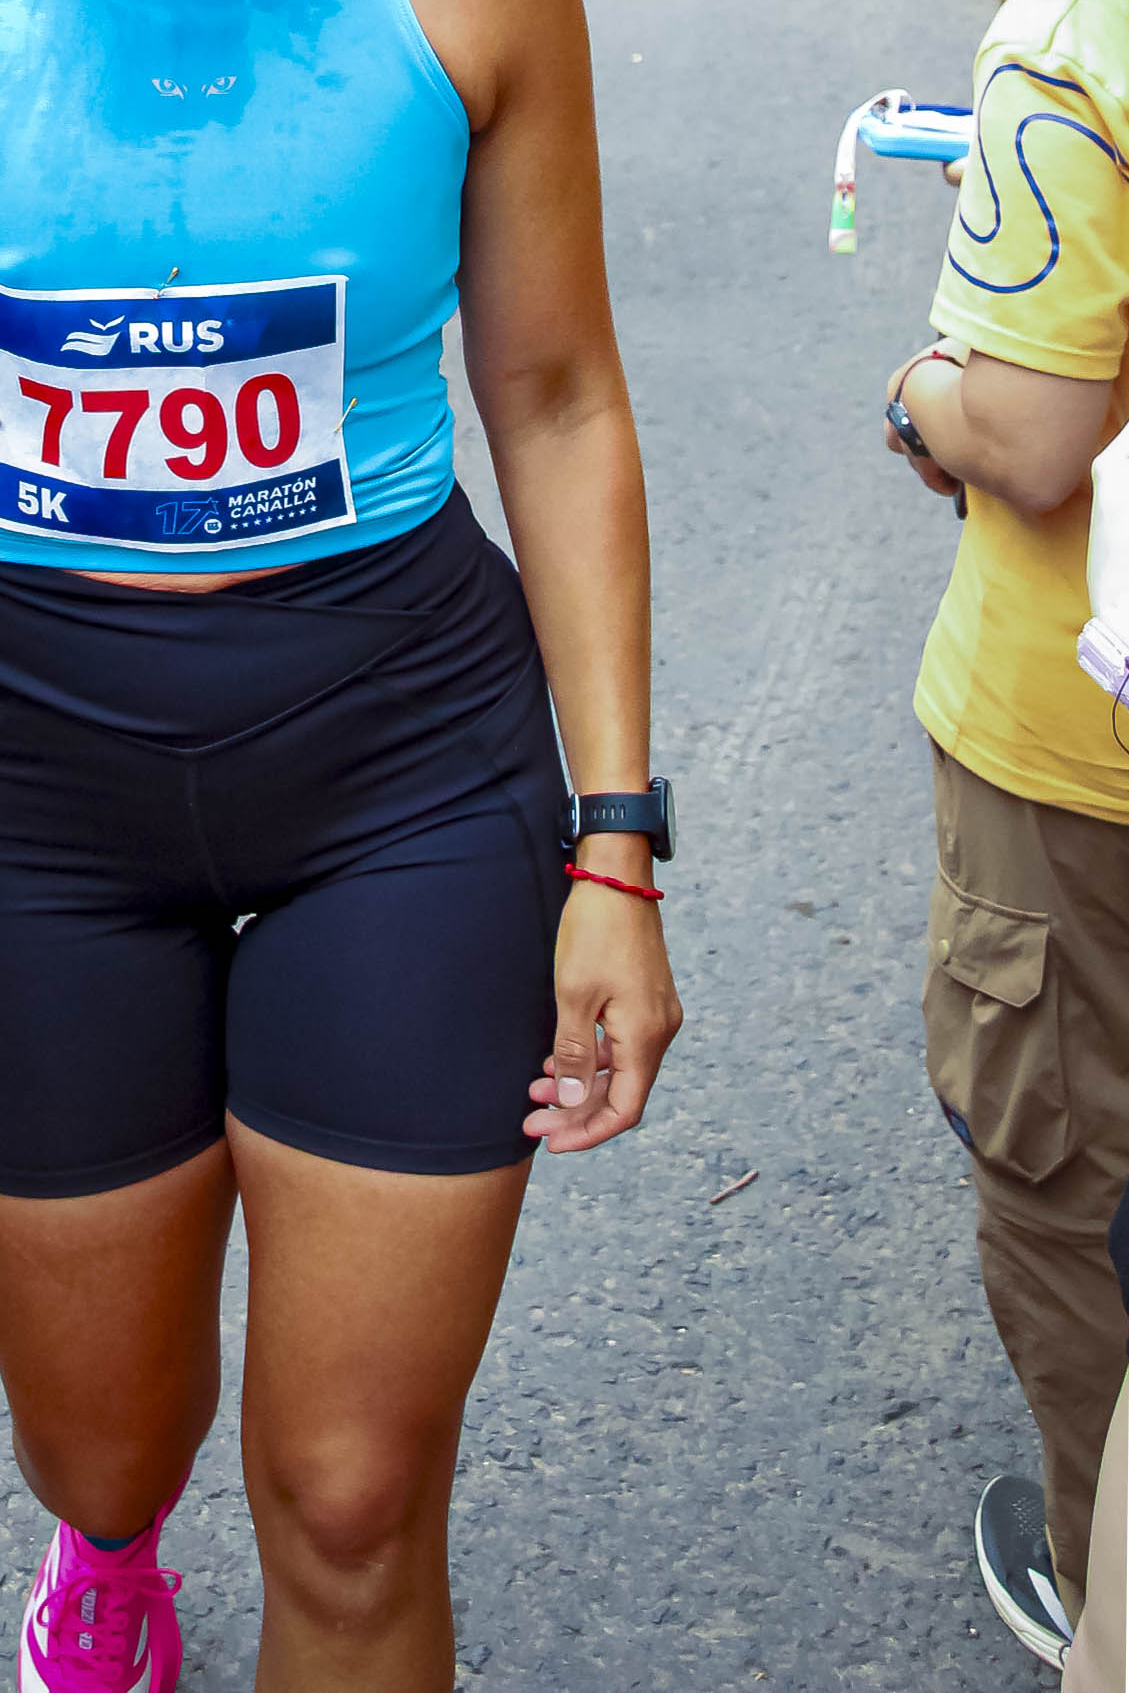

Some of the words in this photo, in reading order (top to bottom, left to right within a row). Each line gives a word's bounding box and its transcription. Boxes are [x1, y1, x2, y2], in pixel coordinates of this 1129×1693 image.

[129, 319, 225, 354] RUS
[18, 371, 301, 481] 7790
[17, 480, 69, 523] 5K
[228, 476, 317, 508] MARATÓN
[230, 491, 317, 519] CANALLA
[155, 497, 219, 535] 17
